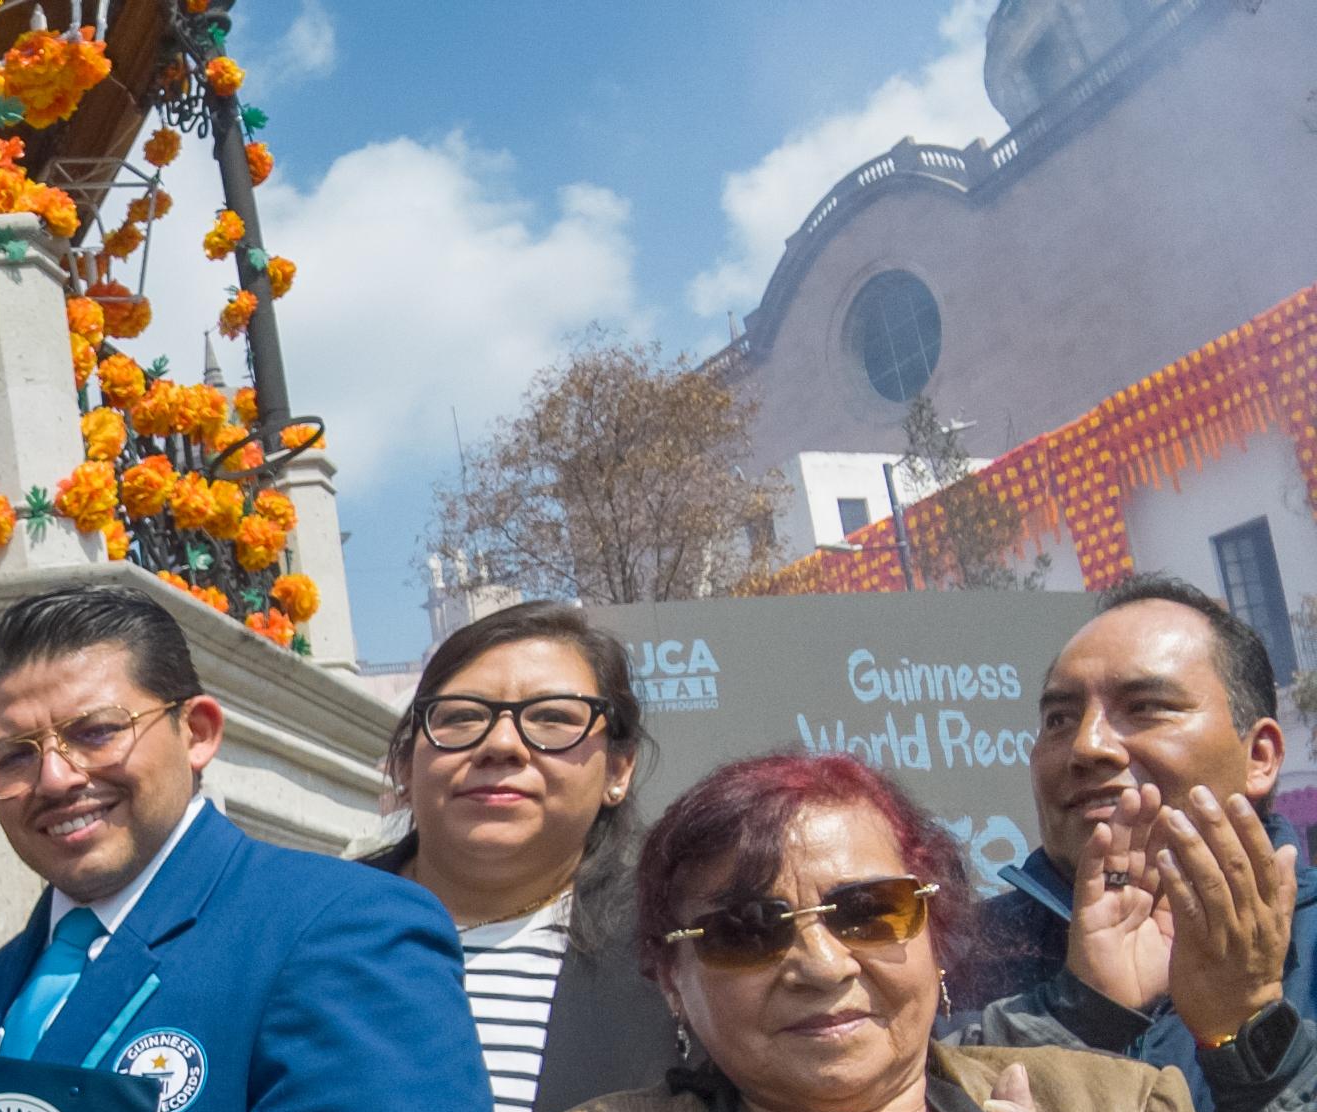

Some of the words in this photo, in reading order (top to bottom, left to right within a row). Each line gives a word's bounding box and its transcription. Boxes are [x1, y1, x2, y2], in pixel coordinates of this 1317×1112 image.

[847, 648, 1022, 706] Guinness
[938, 709, 1037, 769] Reco
[126, 1034, 196, 1059] GUINNESS
[161, 1066, 200, 1112] ECORDS
